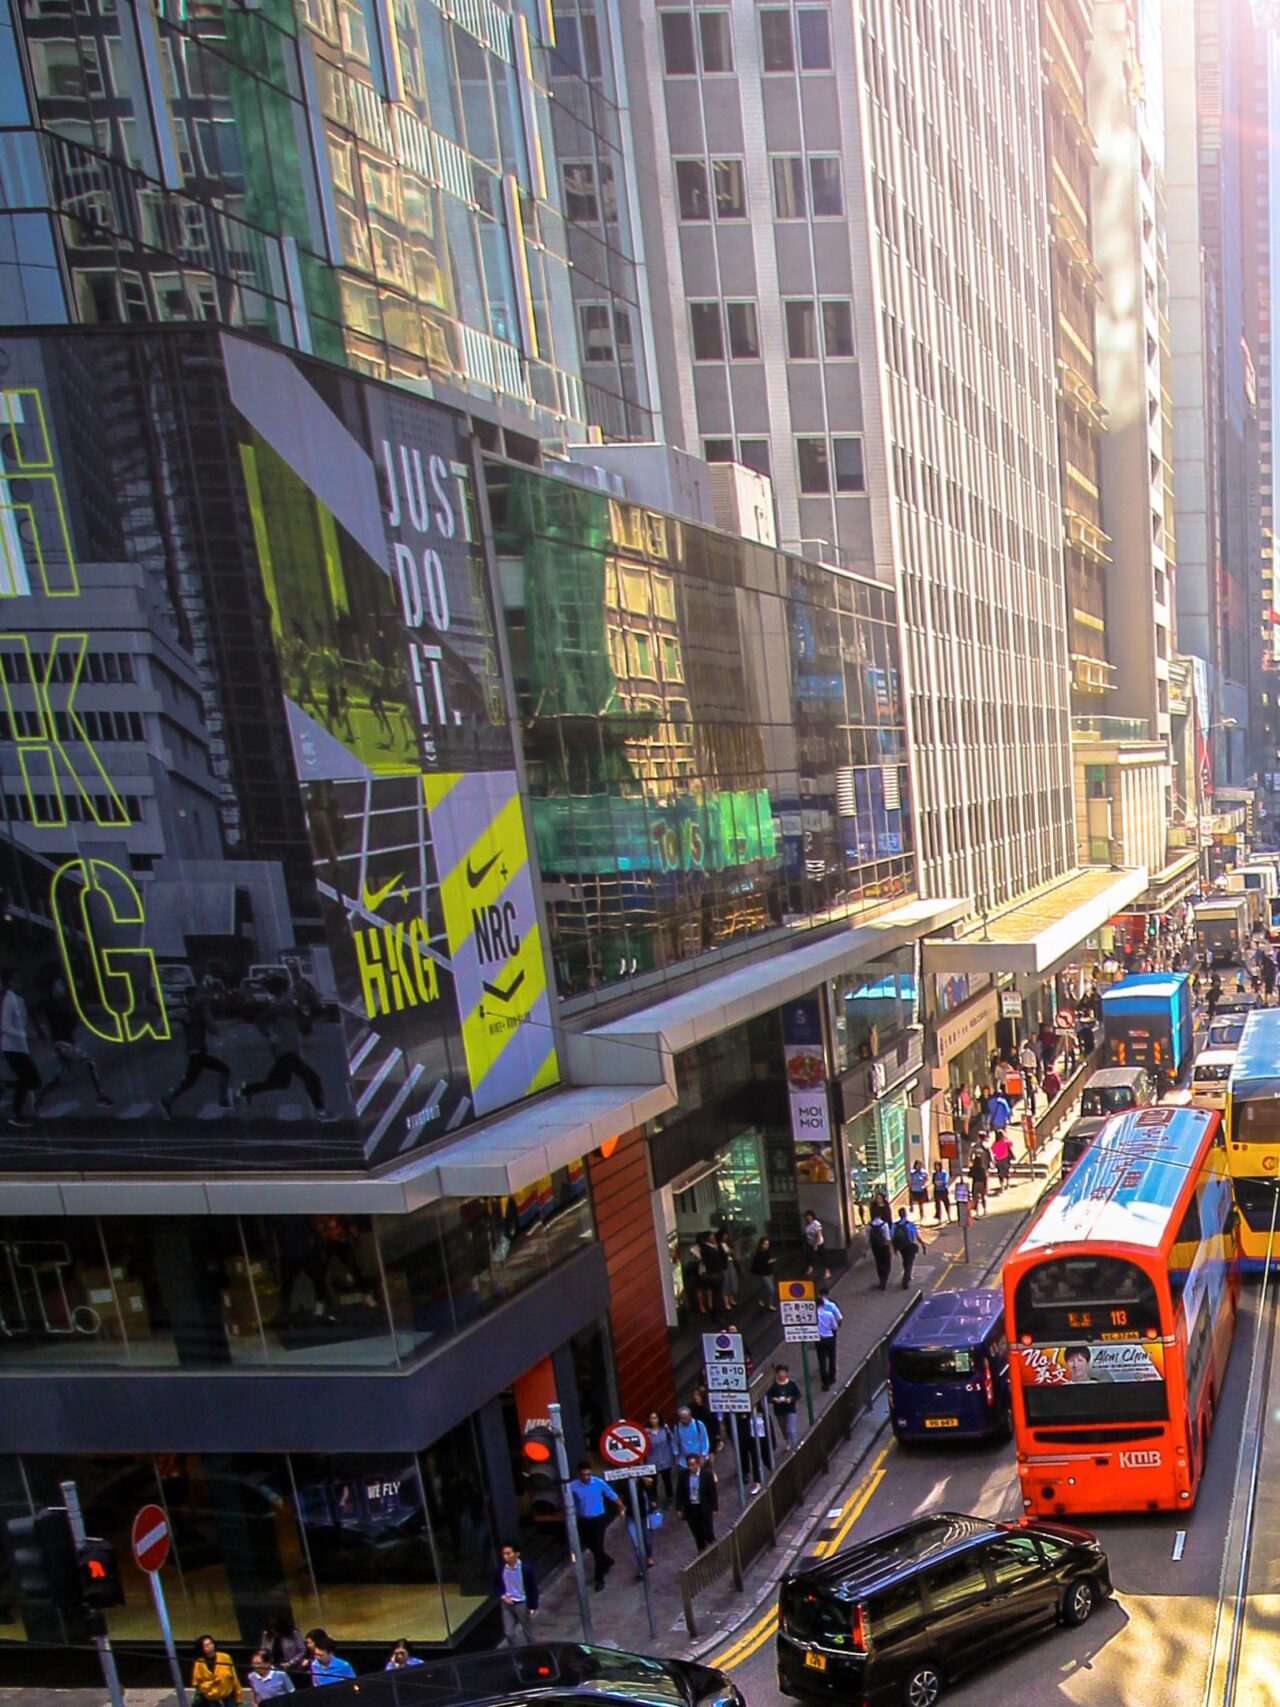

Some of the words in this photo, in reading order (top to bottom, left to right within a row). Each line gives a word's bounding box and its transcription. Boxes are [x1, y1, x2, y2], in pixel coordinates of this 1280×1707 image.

[382, 439, 473, 543] JUST
[394, 542, 450, 631] DO
[408, 643, 462, 726] IT.
[472, 900, 521, 965] NRC
[353, 916, 440, 1020] HKG
[799, 1106, 823, 1117] MOI
[800, 1118, 824, 1129] MOI
[1110, 1310, 1128, 1326] 113
[1022, 1347, 1058, 1368] No.1
[1093, 1349, 1119, 1364] Alan
[721, 1366, 744, 1375] 8-10
[1034, 1365, 1069, 1384] 英文
[1119, 1450, 1162, 1469] KMB
[382, 1481, 401, 1497] FLY
